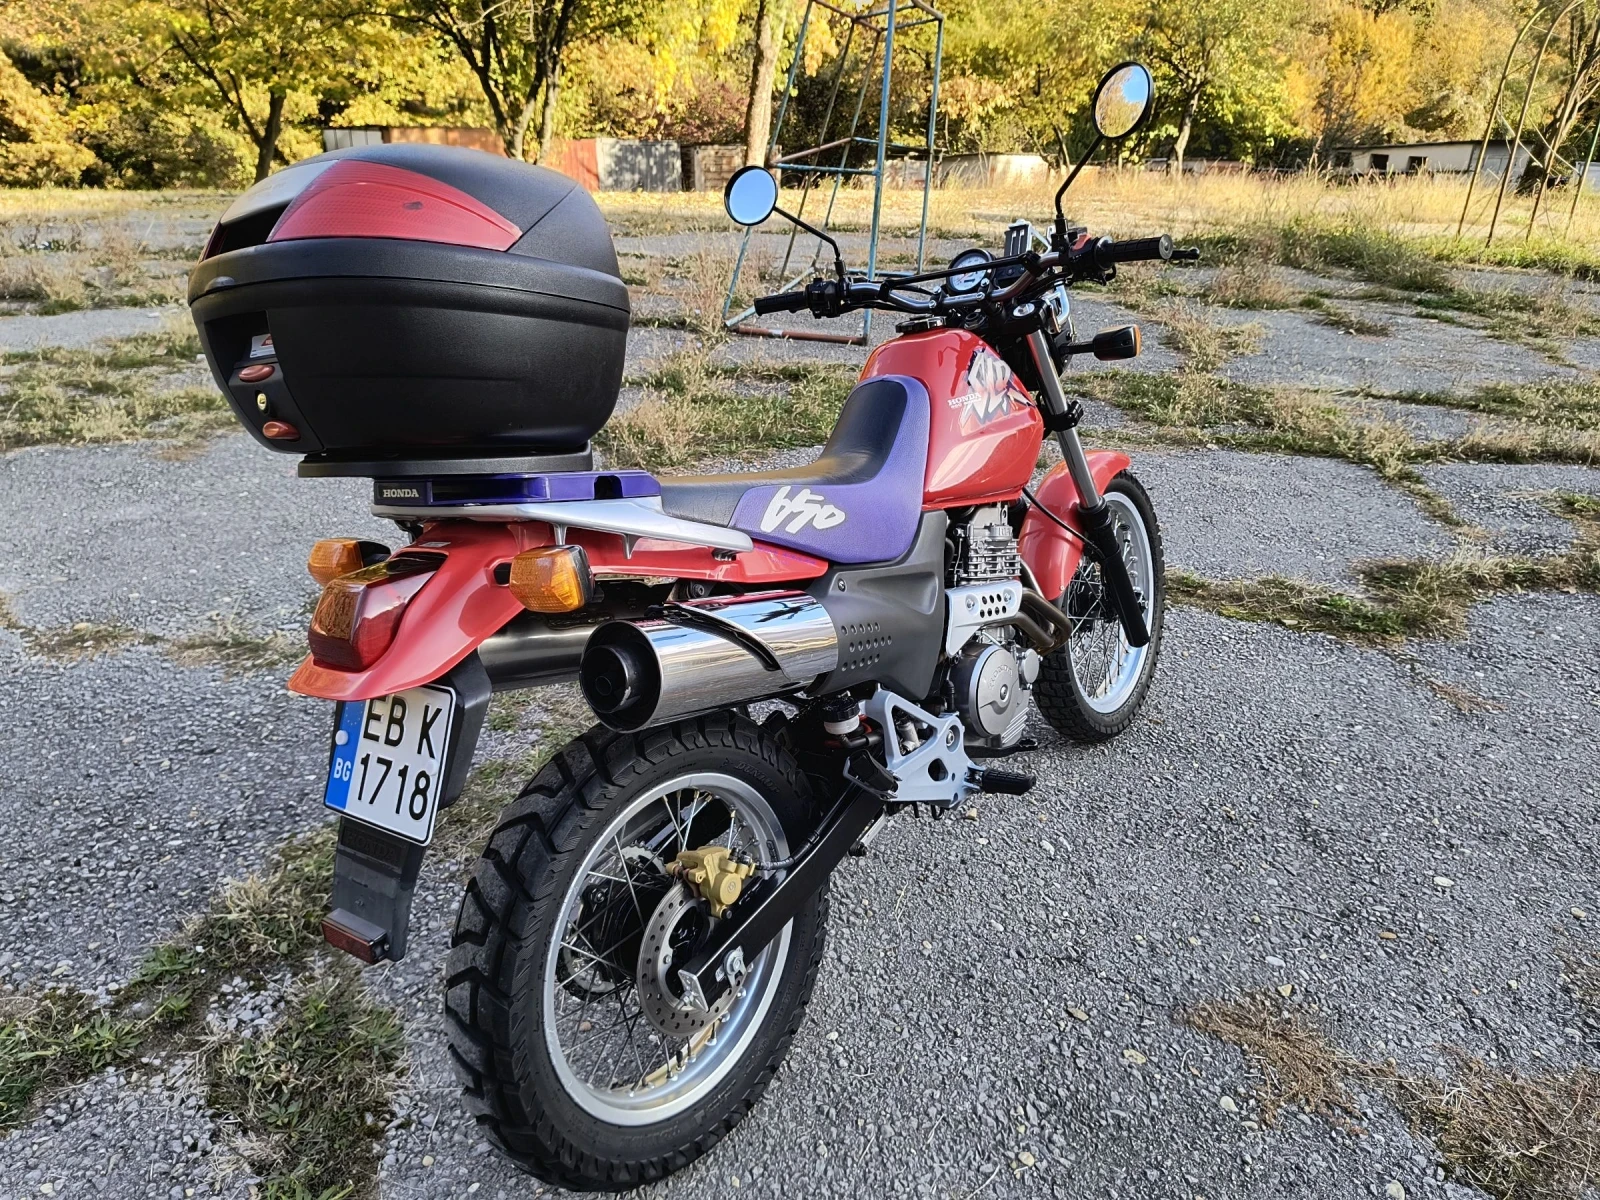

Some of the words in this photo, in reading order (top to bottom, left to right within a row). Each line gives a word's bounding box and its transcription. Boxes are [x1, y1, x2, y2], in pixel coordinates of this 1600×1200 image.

[947, 392, 982, 406] HONDA
[383, 489, 419, 498] HONDA
[760, 485, 845, 534] 650
[363, 694, 407, 747] EB
[417, 705, 443, 759] K
[334, 757, 351, 782] BG
[357, 753, 430, 820] 1718
